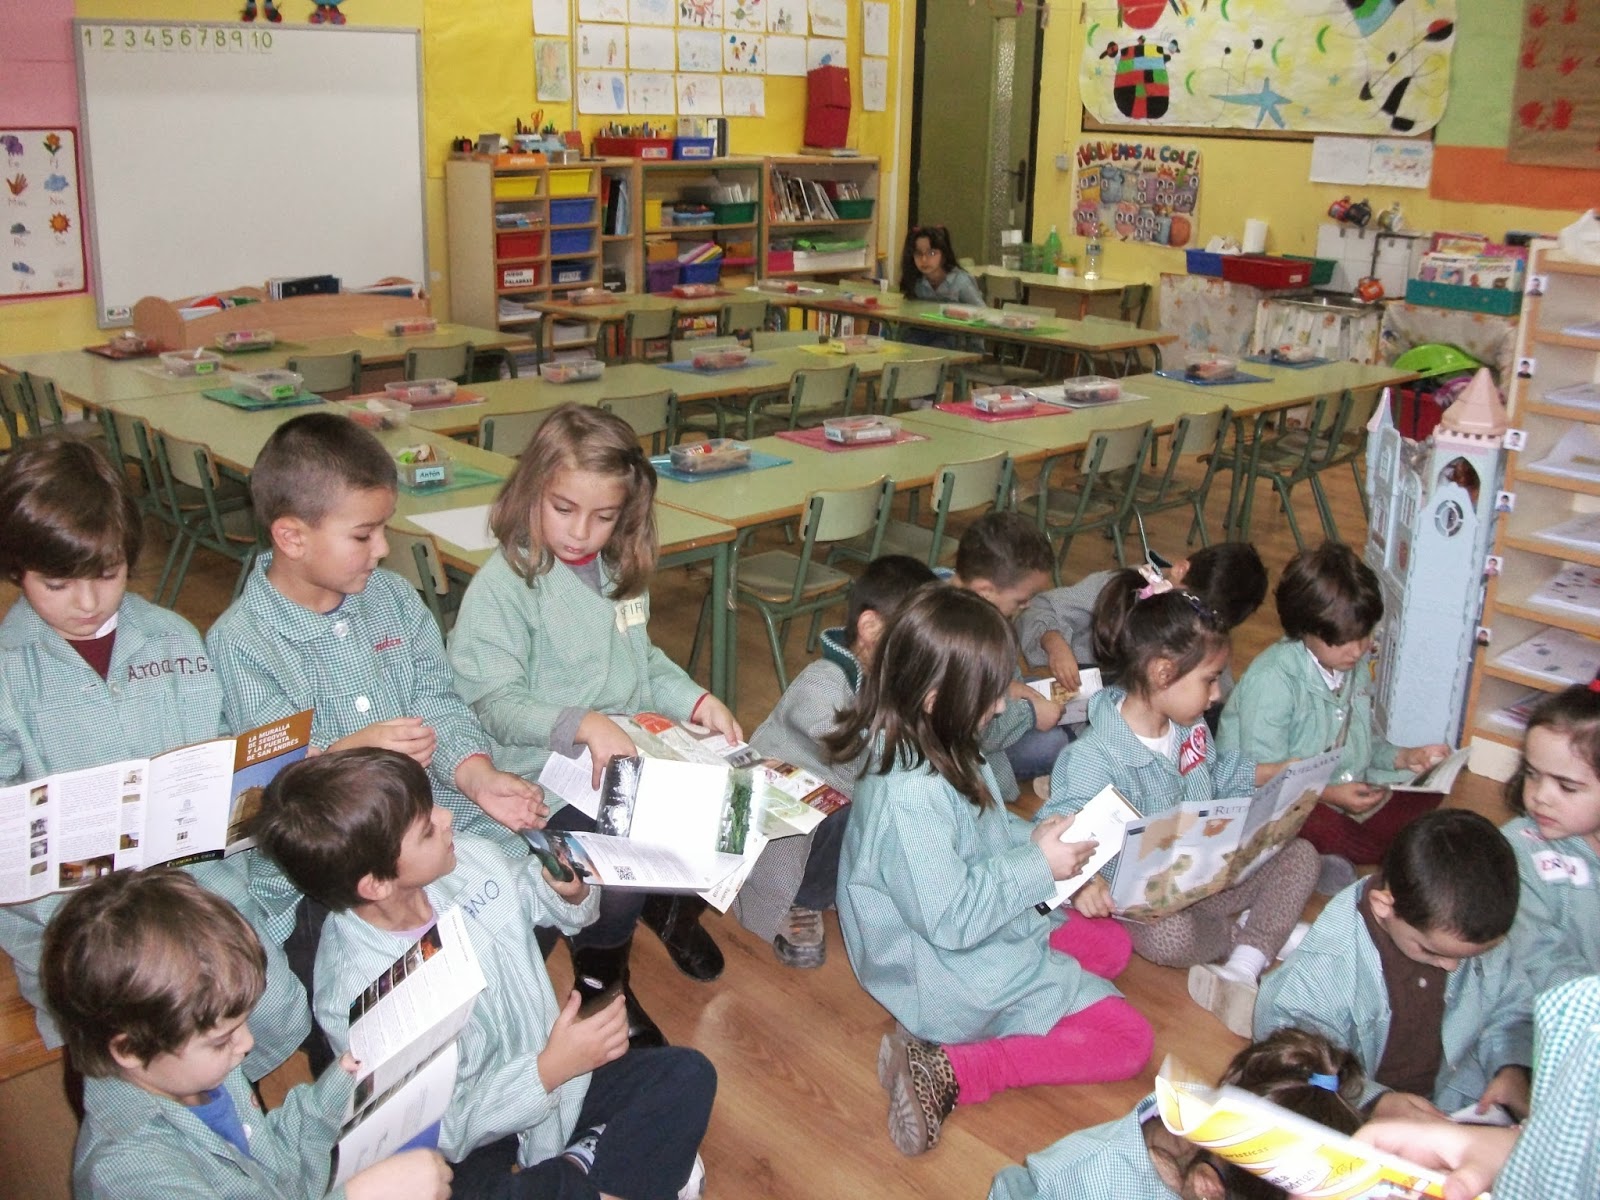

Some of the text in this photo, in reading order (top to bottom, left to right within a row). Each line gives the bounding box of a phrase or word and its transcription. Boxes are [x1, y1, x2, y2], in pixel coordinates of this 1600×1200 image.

[247, 731, 287, 749] DE SEGOVIA
[248, 723, 290, 743] LA MURALLA
[253, 745, 262, 753] LA
[263, 735, 290, 750] PUERTA
[246, 754, 256, 762] DE
[257, 749, 272, 758] SAN
